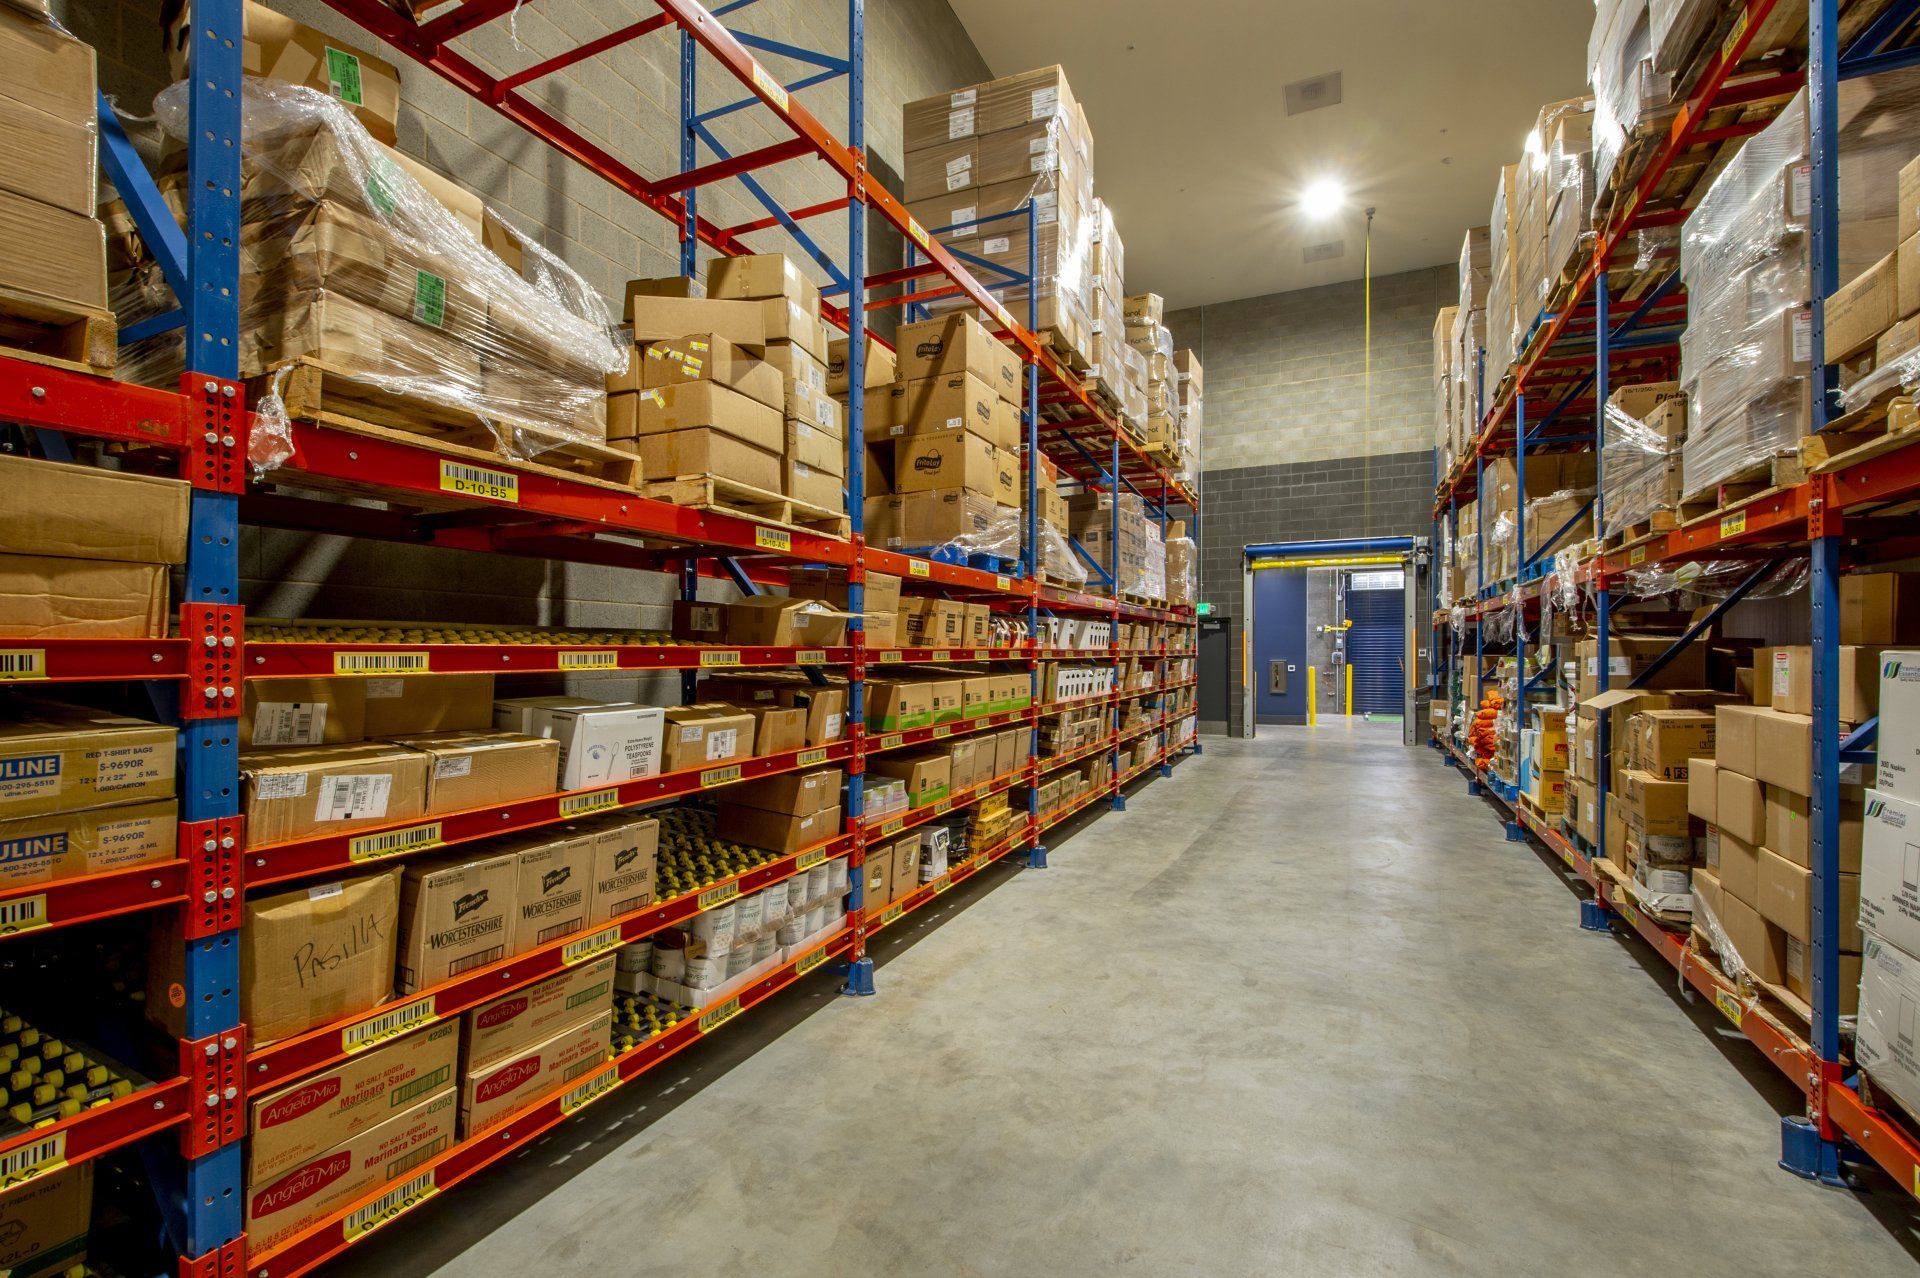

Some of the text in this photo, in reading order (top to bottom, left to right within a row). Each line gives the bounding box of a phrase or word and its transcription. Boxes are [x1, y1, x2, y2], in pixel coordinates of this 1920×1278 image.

[455, 480, 506, 499] D-10-B5
[104, 750, 131, 758] T-SHIRT
[625, 741, 654, 752] POLYSTYRENE
[626, 750, 652, 760] TEASPOONS
[0, 758, 56, 780] LINE
[100, 760, 144, 771] S-9690R
[1664, 767, 1671, 779] 4
[103, 831, 145, 845] S-9690R
[428, 880, 433, 889] 4
[599, 870, 649, 895] WORCESTERSHIRE
[523, 891, 582, 920] WORCESTERSHIRE
[431, 916, 503, 949] WORCESTERSHIRE
[480, 1006, 511, 1026] Angela
[362, 1018, 424, 1048] D-10-D2
[427, 1025, 453, 1043] 42203
[549, 1041, 600, 1073] Marinara Sauce
[340, 1080, 385, 1108] Marinara
[388, 1067, 416, 1087] Sauce
[355, 1063, 404, 1090] NO SALT ADDED
[480, 1062, 538, 1099] Angela Mia
[266, 1092, 312, 1124] Angela
[314, 1080, 337, 1099] Mia
[427, 1096, 453, 1116] 42203
[364, 1125, 438, 1170] Marinara Sauce
[379, 1122, 427, 1150] NO SALT ADDED
[258, 1176, 314, 1214] Angela
[316, 1157, 346, 1183] Mia
[361, 1191, 425, 1232] D-10-D1
